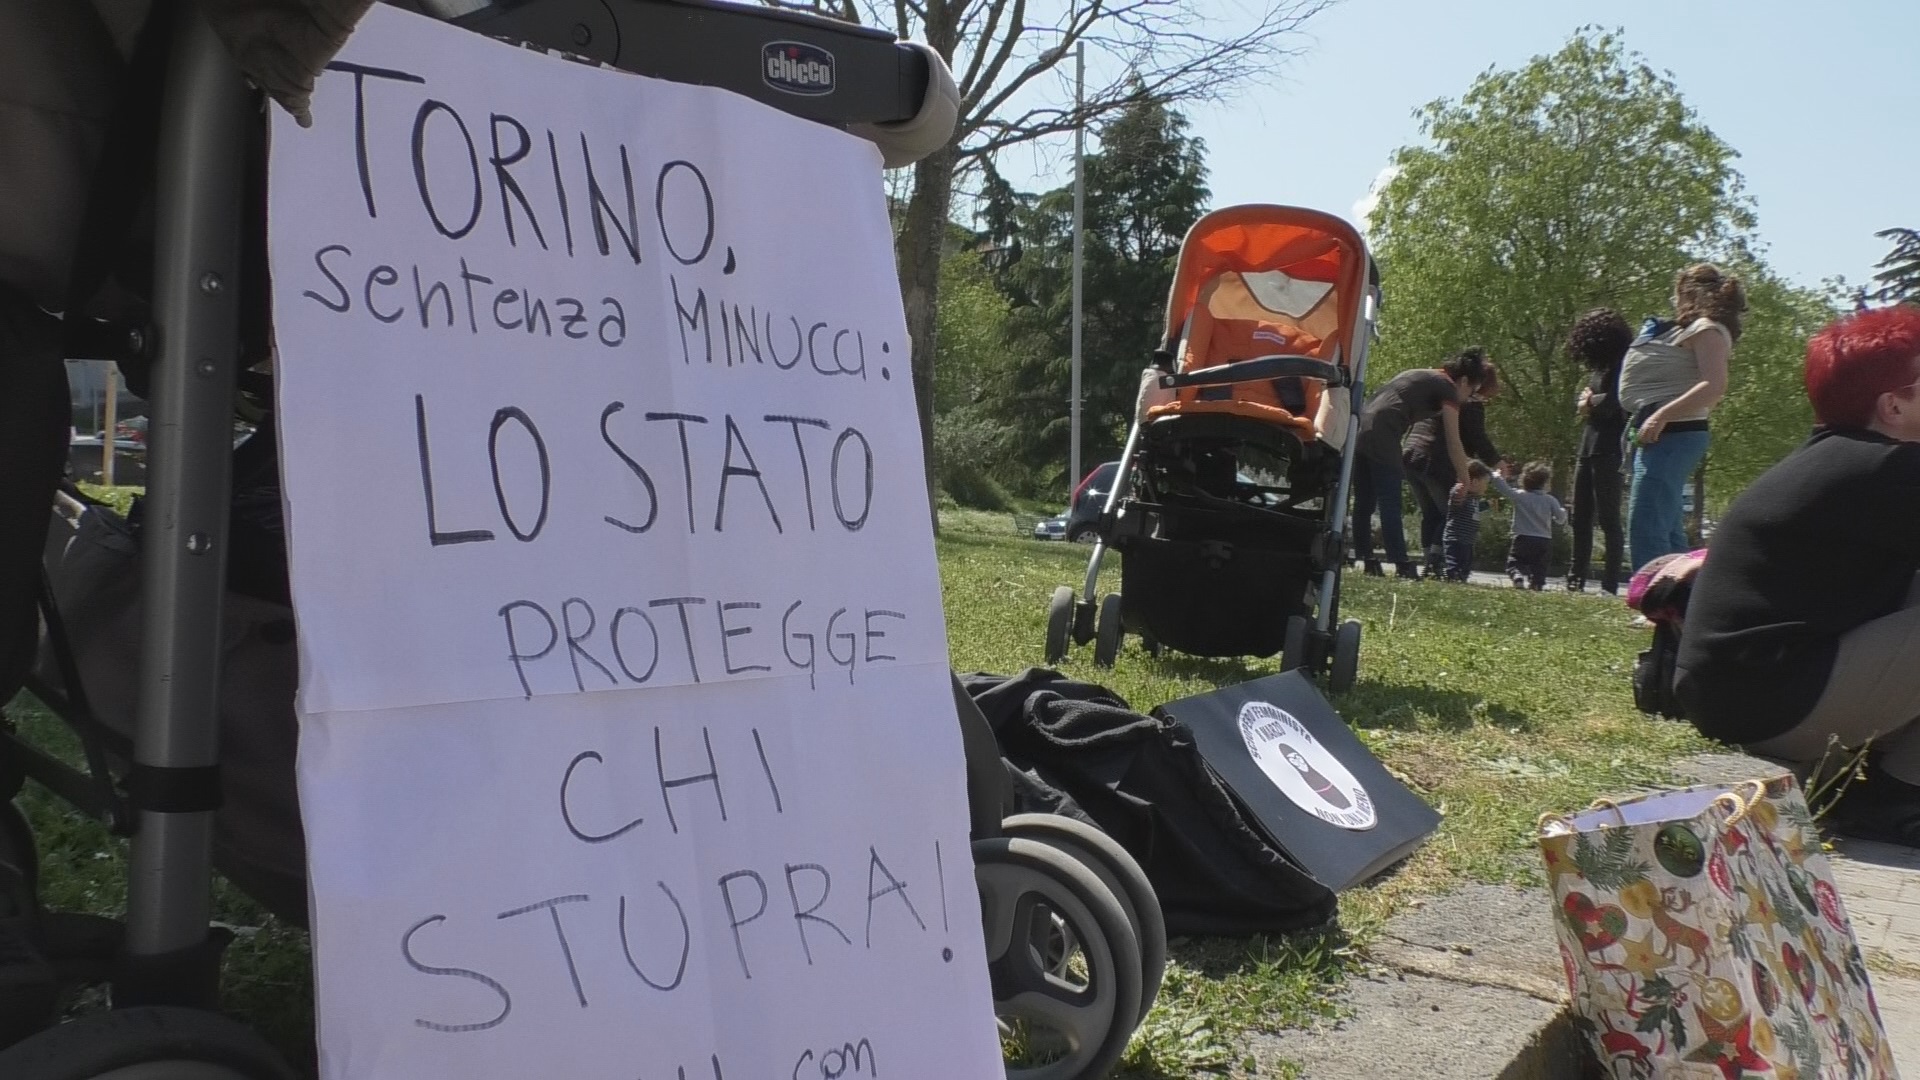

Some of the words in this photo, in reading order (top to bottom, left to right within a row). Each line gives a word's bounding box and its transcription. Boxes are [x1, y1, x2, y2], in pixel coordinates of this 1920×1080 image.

[767, 47, 831, 85] chicco
[324, 61, 737, 276] TORINO,
[415, 393, 550, 547] LO
[600, 401, 874, 535] STATO
[498, 596, 907, 700] PROTEGGE
[560, 725, 784, 844] CHI
[1258, 720, 1287, 741] MARZO
[1314, 807, 1345, 825] NON
[1340, 812, 1363, 826] UNA
[1352, 787, 1371, 816] MENO
[402, 840, 956, 1031] STUPRA!
